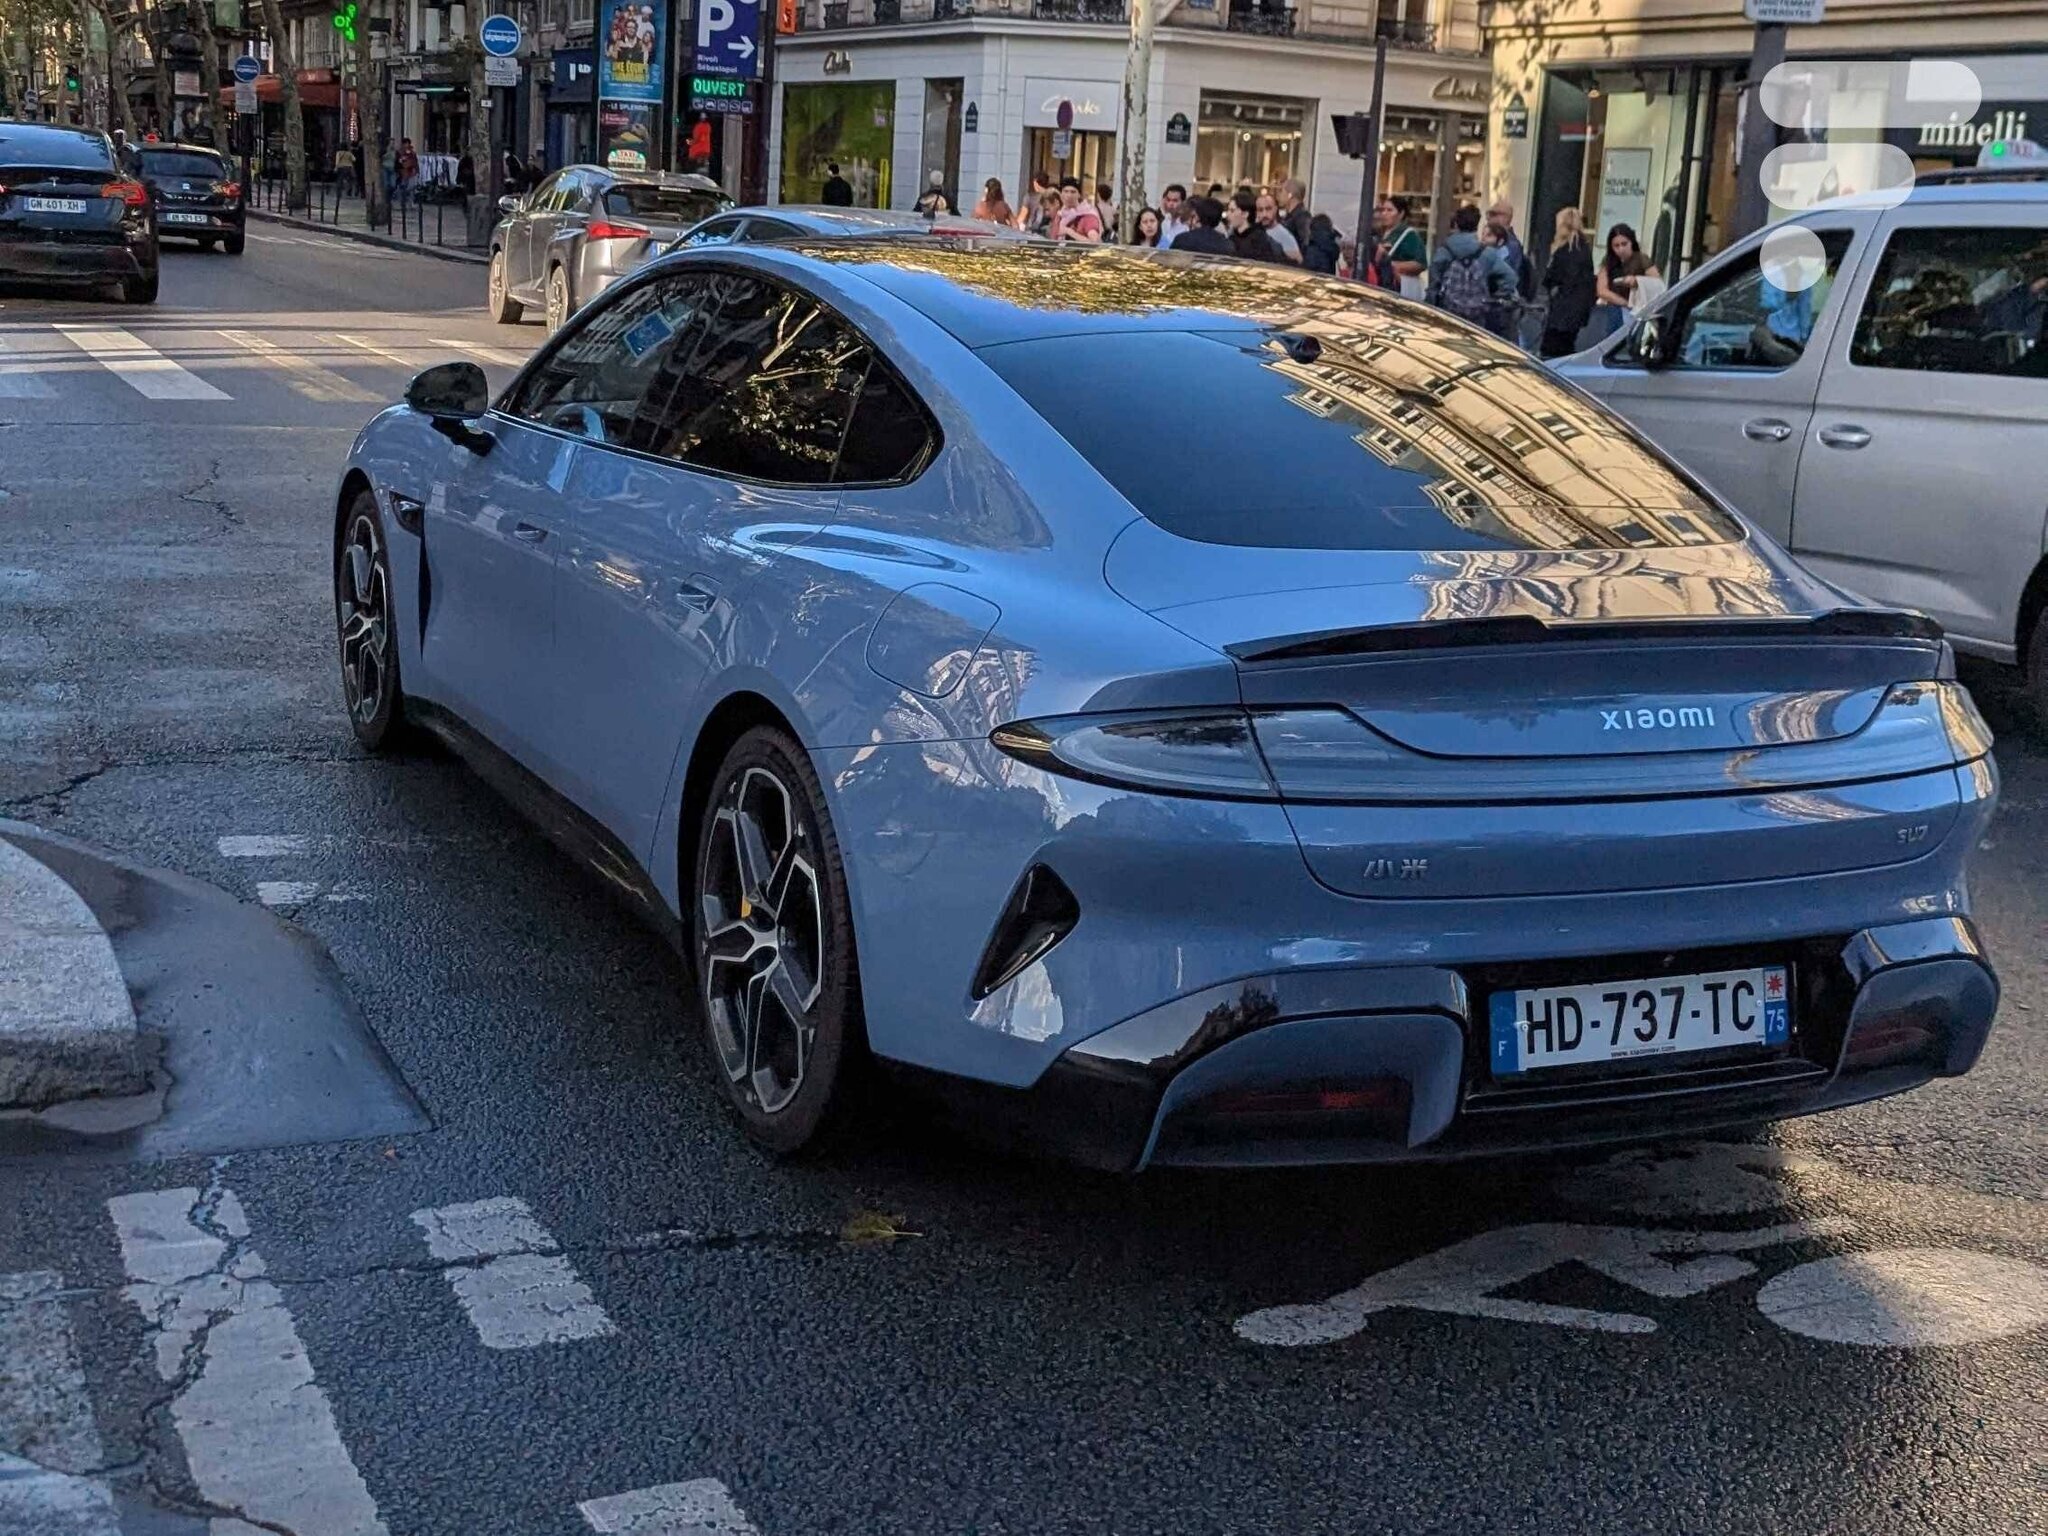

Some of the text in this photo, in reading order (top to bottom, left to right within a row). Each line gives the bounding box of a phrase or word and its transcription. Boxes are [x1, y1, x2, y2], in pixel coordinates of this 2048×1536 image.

[698, 0, 735, 47] P
[697, 54, 719, 63] Rivoli
[693, 78, 745, 97] OUVERT
[1918, 111, 2027, 146] minelli
[1498, 980, 1786, 1057] F HD-737-TC 75
